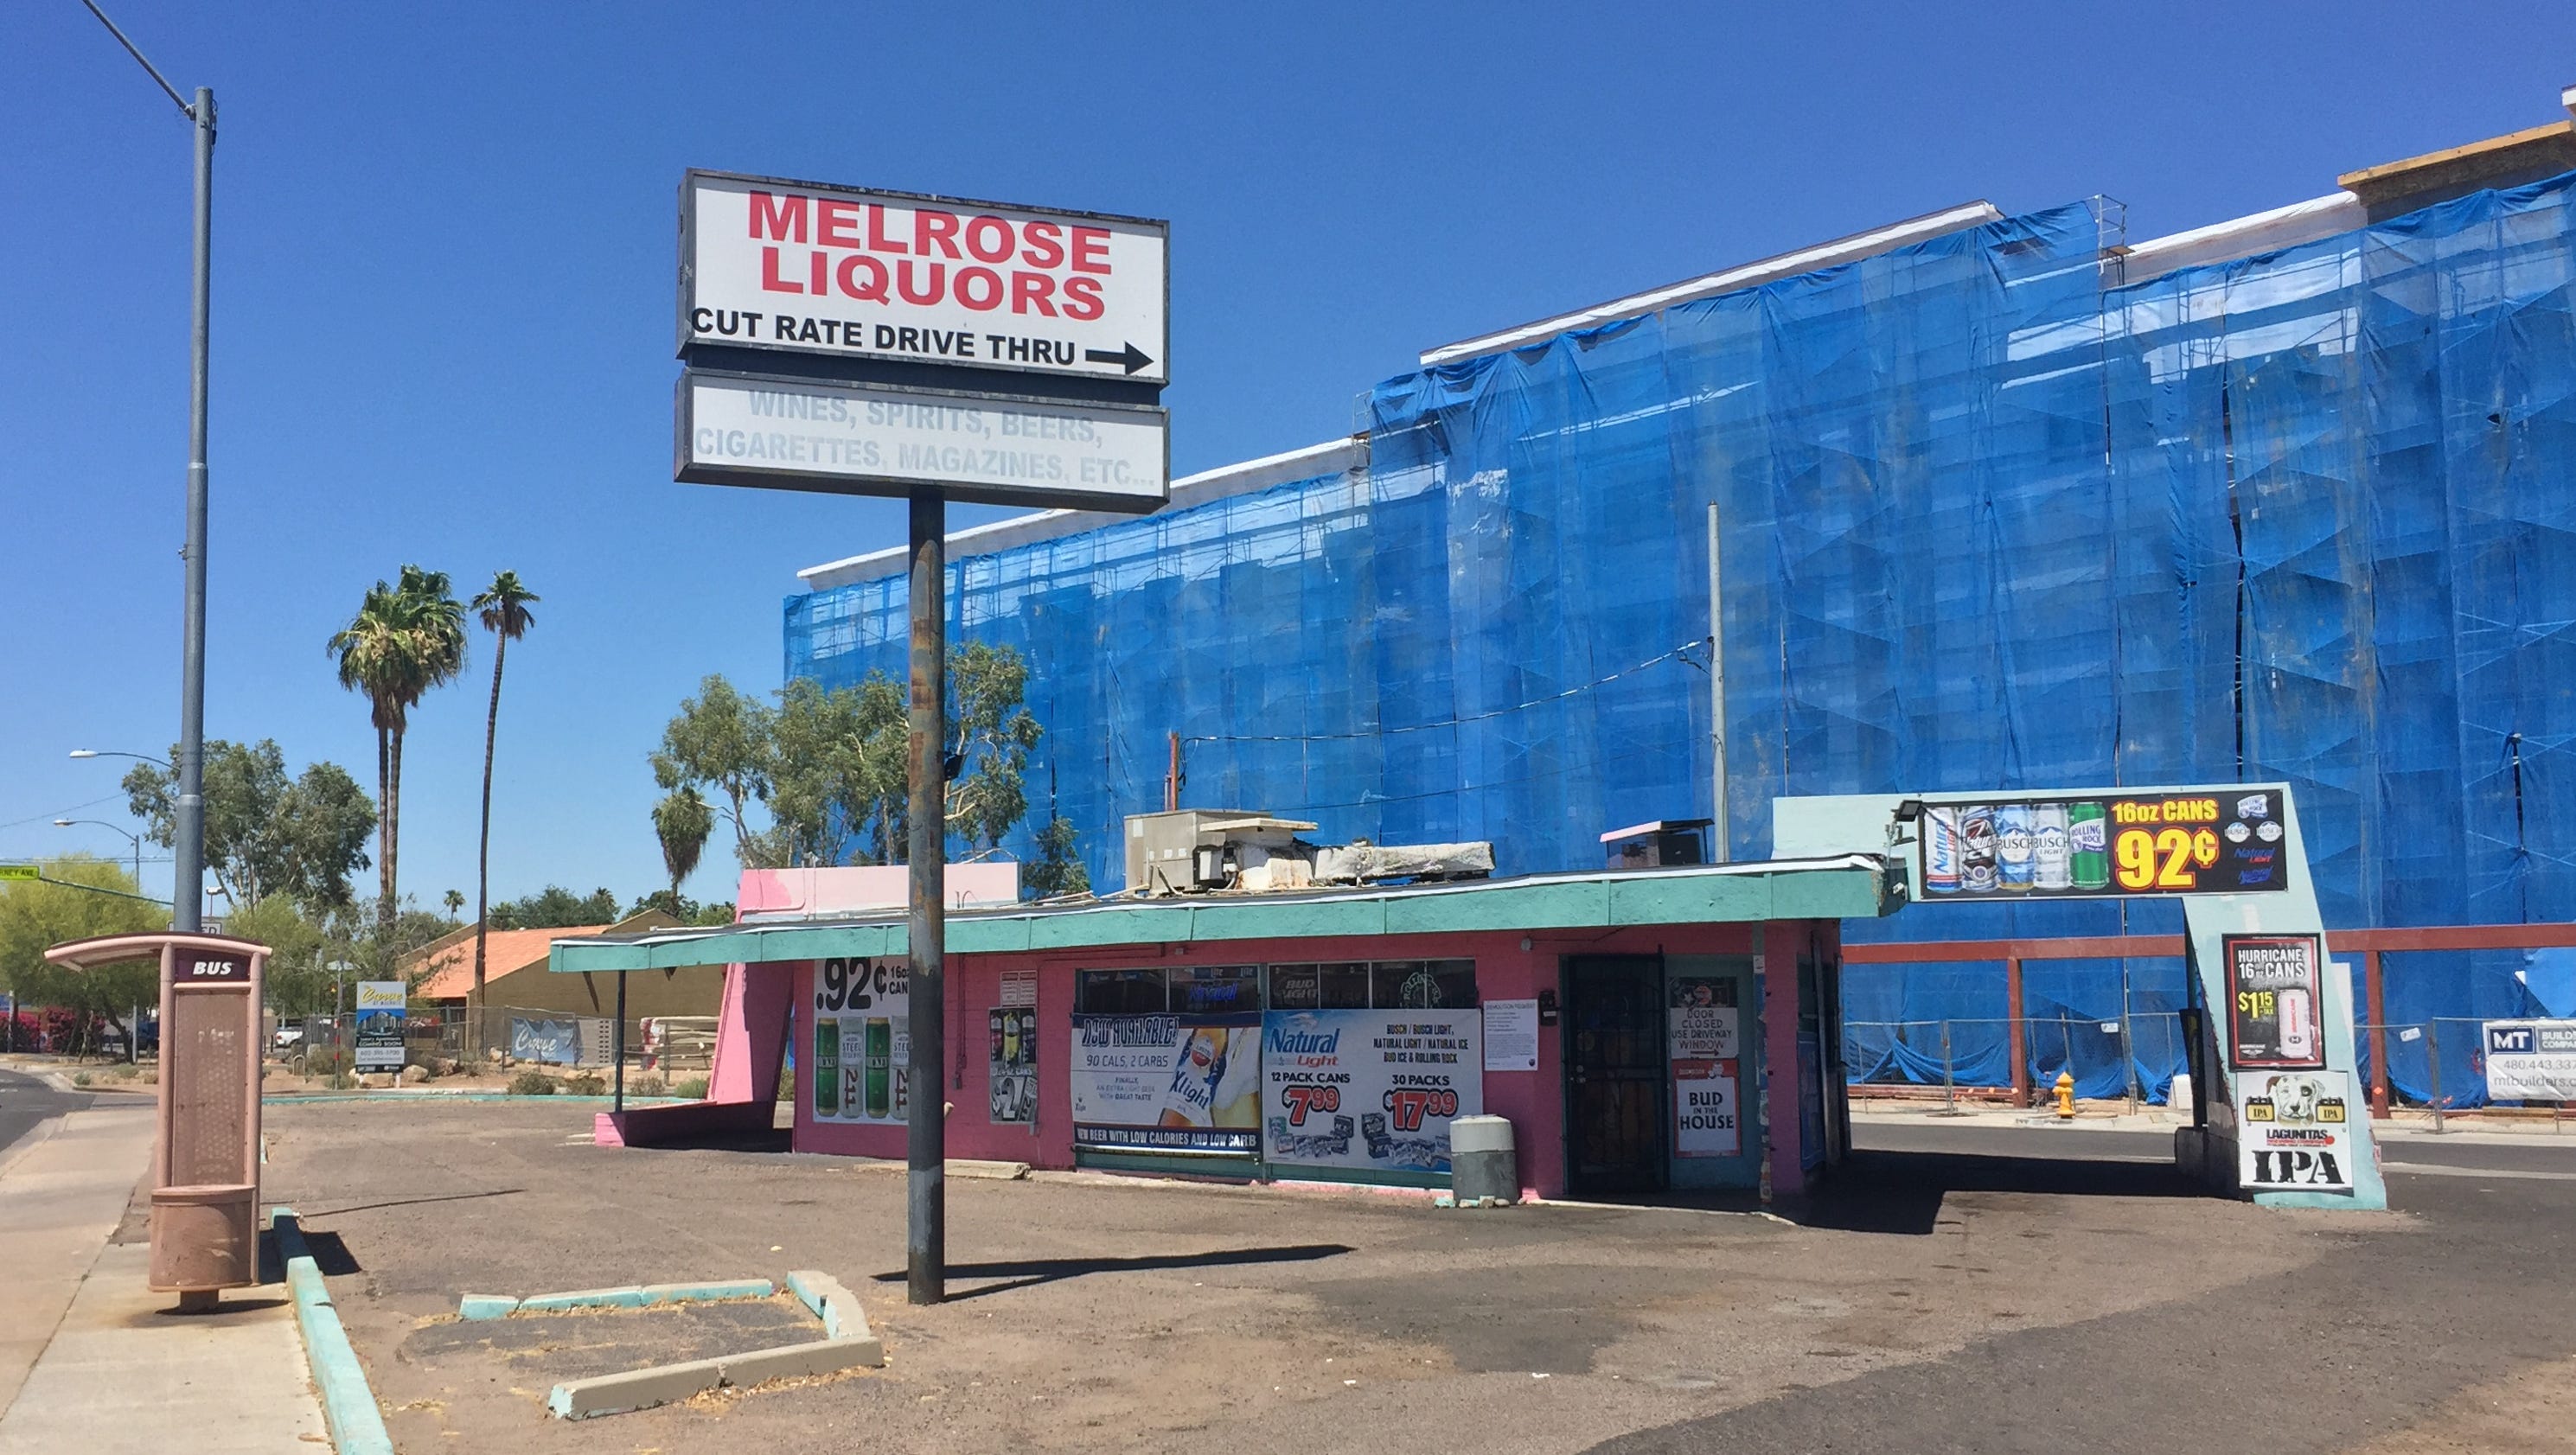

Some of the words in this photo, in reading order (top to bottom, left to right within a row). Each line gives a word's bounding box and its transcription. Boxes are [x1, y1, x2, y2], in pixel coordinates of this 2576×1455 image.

[749, 190, 1111, 274] MELROSE
[762, 246, 1105, 321] LIQUORS
[691, 307, 763, 338] CUT
[776, 316, 863, 348] RATE
[875, 325, 975, 358] DRIVE
[987, 335, 1076, 366] THRU
[748, 389, 856, 429] WINES,
[867, 400, 991, 440] SPIRITS,
[1002, 411, 1103, 448] BEERS,
[695, 428, 888, 472] CIGARETTES,
[898, 442, 1071, 484] MAGAZINES,
[2112, 801, 2161, 824] 16oz
[2163, 799, 2217, 822] CANS
[2117, 828, 2216, 888] 92¢
[2238, 949, 2303, 962] HURRICANE
[193, 961, 232, 975] BUS
[2239, 963, 2254, 979] 16
[2266, 962, 2304, 978] CANS
[1286, 980, 1315, 989] BUD
[1686, 1010, 1714, 1018] DOOR
[1681, 1019, 1723, 1028] CLOSED
[1082, 1018, 1111, 1048] NOW
[1671, 1030, 1688, 1038] USE
[1691, 1030, 1732, 1038] DRIVEWAY
[2493, 1031, 2530, 1049] MT
[1269, 1028, 1340, 1053] Natural
[1373, 1038, 1403, 1049] NATURAL
[1404, 1038, 1421, 1049] LIGHT
[1428, 1038, 1457, 1050] NATURAL
[1458, 1039, 1468, 1050] ICE
[1678, 1040, 1724, 1050] WINDOW
[1086, 1055, 1100, 1067] 90
[1103, 1055, 1128, 1069] CALS,
[1131, 1055, 1136, 1067] 2
[1138, 1055, 1168, 1068] CARBS
[1416, 1053, 1440, 1063] ROLLING
[1271, 1072, 1281, 1082] 12
[1282, 1072, 1314, 1082] PACK
[1317, 1073, 1351, 1083] CANS
[1392, 1075, 1406, 1085] 30
[1409, 1075, 1449, 1086] PACKS
[1169, 1070, 1210, 1110] Xlight
[1689, 1092, 1723, 1106] BUD
[2253, 1108, 2268, 1118] IPA
[2324, 1109, 2338, 1119] IPA
[1679, 1115, 1735, 1130] HOUSE
[1090, 1129, 1107, 1141] BEER
[1109, 1130, 1128, 1142] WITH
[1130, 1131, 1147, 1143] LOW
[1149, 1132, 1189, 1145] CALORIES
[1191, 1133, 1208, 1145] AND
[1210, 1134, 1228, 1146] LOW
[2266, 1129, 2328, 1139] LAGUNITAS
[2252, 1150, 2345, 1184] IPA
